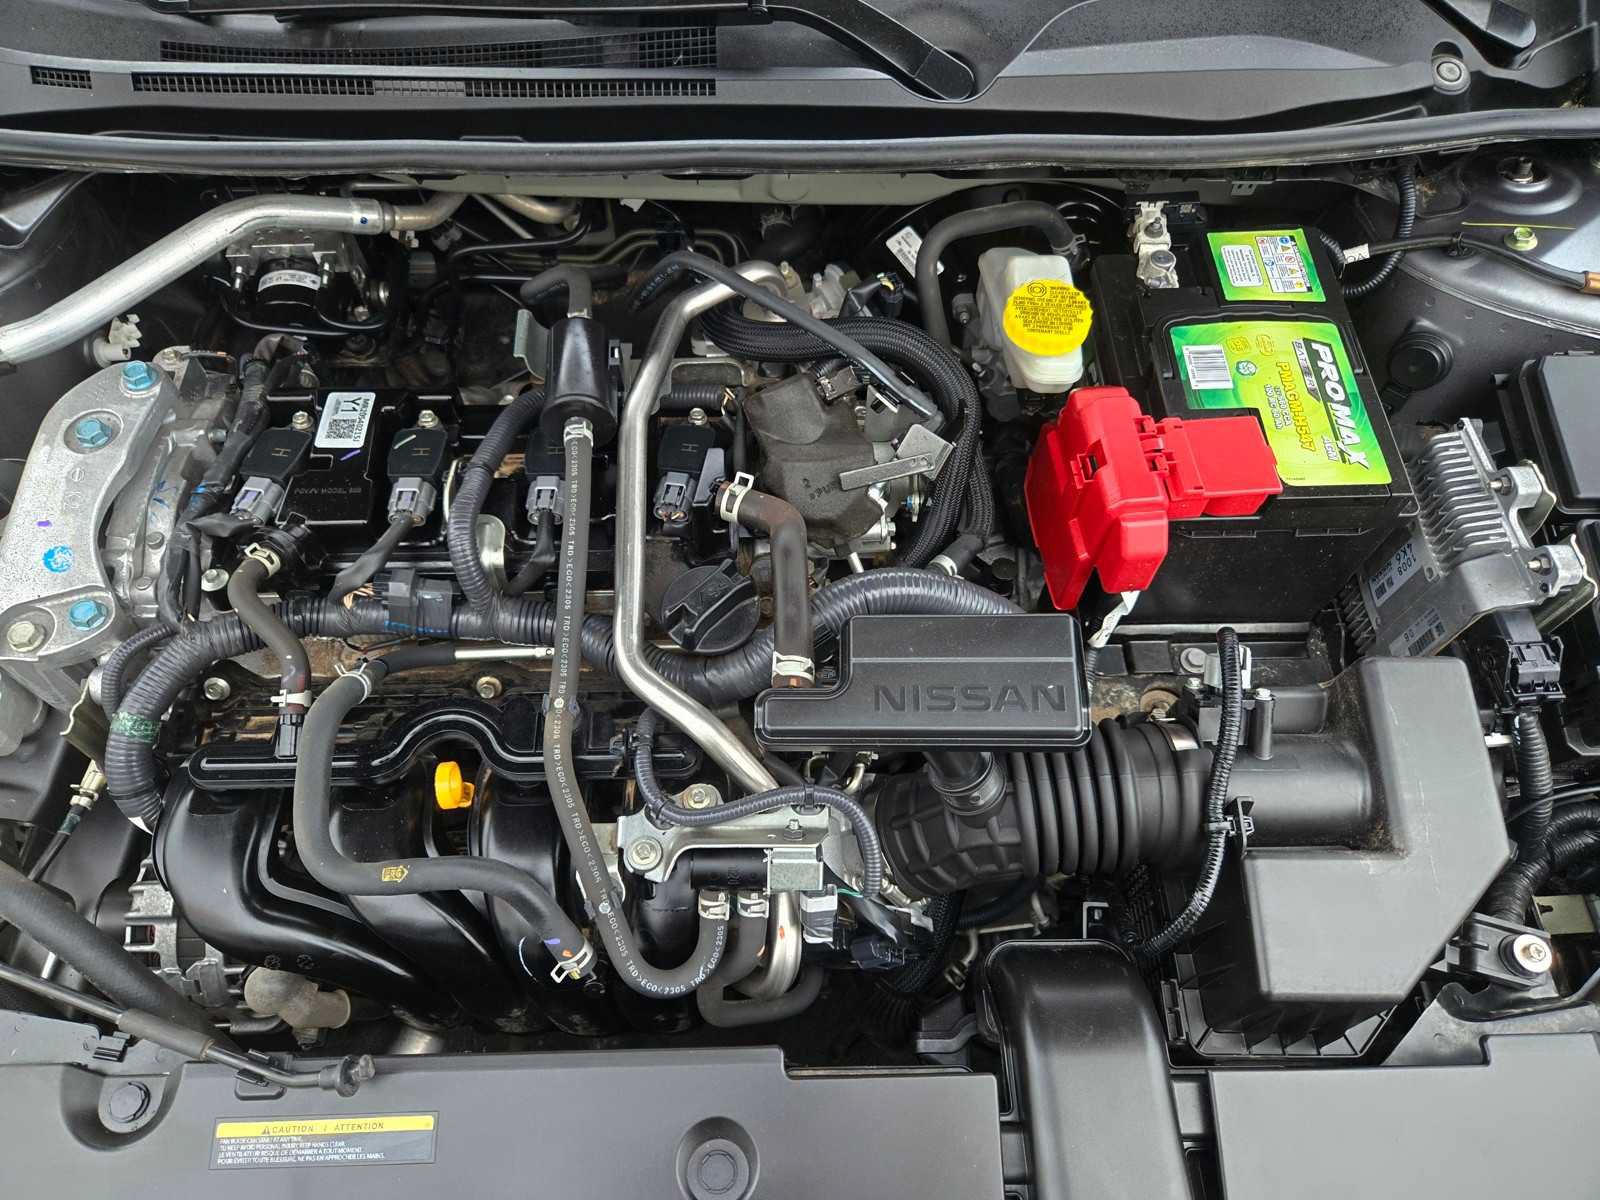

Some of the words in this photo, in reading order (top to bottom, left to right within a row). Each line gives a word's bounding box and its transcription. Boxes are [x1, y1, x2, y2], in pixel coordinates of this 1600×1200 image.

[340, 396, 362, 413] Y1
[1311, 342, 1369, 470] PROMAX
[873, 684, 1066, 712] NISSAN
[272, 1125, 314, 1134] CAUTION
[334, 1122, 385, 1131] ATTENTION
